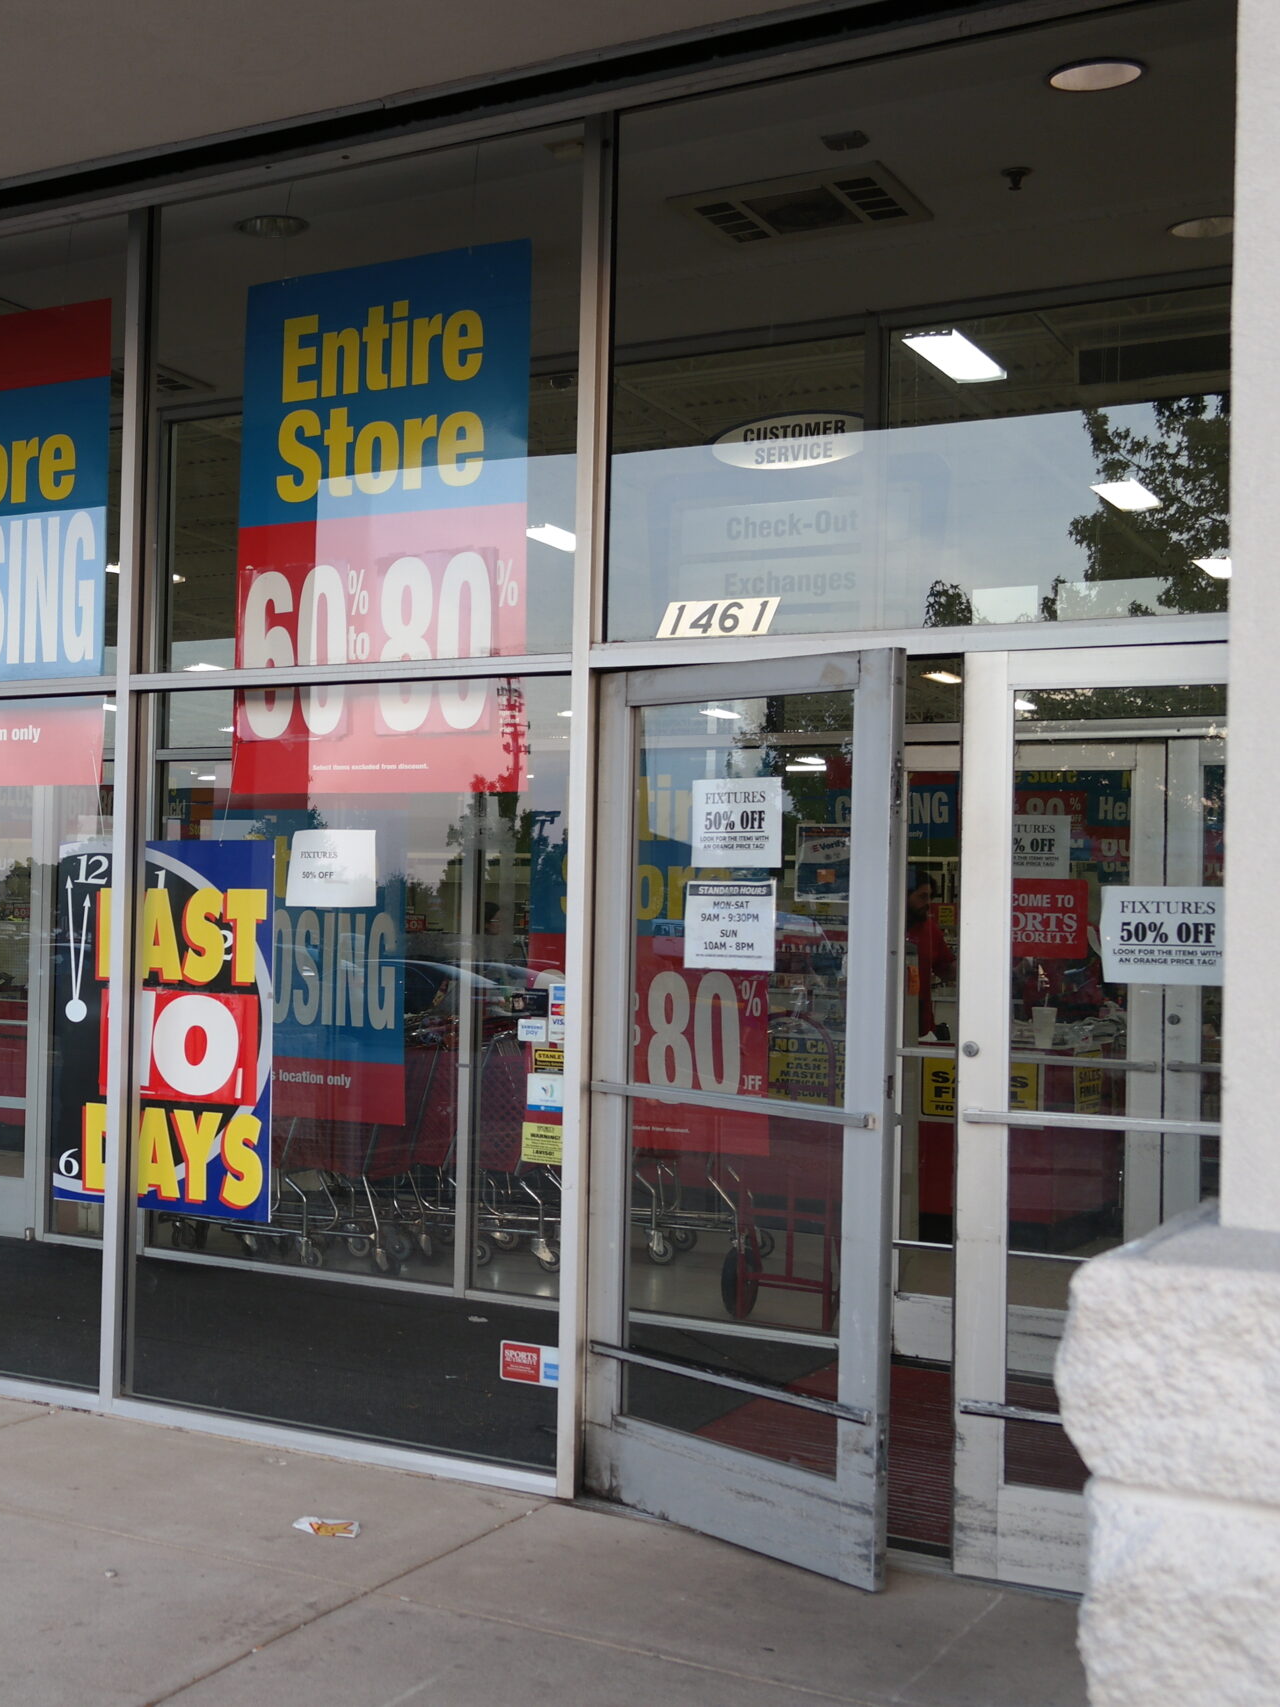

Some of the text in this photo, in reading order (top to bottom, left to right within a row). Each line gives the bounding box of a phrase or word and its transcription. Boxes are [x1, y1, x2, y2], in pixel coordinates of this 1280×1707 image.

[281, 299, 485, 404] Entire
[743, 419, 846, 445] CUSTOMER
[275, 405, 485, 504] Store
[754, 441, 833, 465] SERVICE
[726, 510, 859, 541] Check-Out
[724, 570, 856, 596] Exchanges
[670, 599, 769, 636] 1461
[348, 626, 369, 660] to
[11, 725, 41, 743] only
[705, 790, 766, 804] FIXTURES
[704, 810, 765, 830] 50% OFF
[1031, 838, 1055, 852] OFF
[300, 851, 338, 859] FIXTURES
[74, 854, 109, 885] 12
[302, 871, 334, 879] 50% OFF
[698, 886, 767, 894] STANDARD HOURS
[712, 901, 750, 909] MON-SAT
[1011, 893, 1074, 908] COME TO
[1120, 900, 1216, 915] FIXTURES
[701, 913, 719, 922] 9AM
[728, 913, 759, 922] 9:30PM
[1011, 912, 1077, 932] ORTS
[720, 929, 738, 938] SUN
[1120, 921, 1216, 943] 50% OFF
[704, 942, 727, 950] 10AM
[735, 942, 754, 951] 8PM
[272, 909, 396, 1031] OSING
[775, 1039, 798, 1051] NO
[786, 1062, 820, 1071] CASH
[279, 1070, 324, 1085] location
[327, 1073, 352, 1088] only
[1079, 1070, 1101, 1083] SALES
[1079, 1085, 1100, 1098] FINAL
[935, 1103, 954, 1111] NO
[59, 1148, 80, 1177] 6
[505, 1349, 537, 1361] SPORTS
